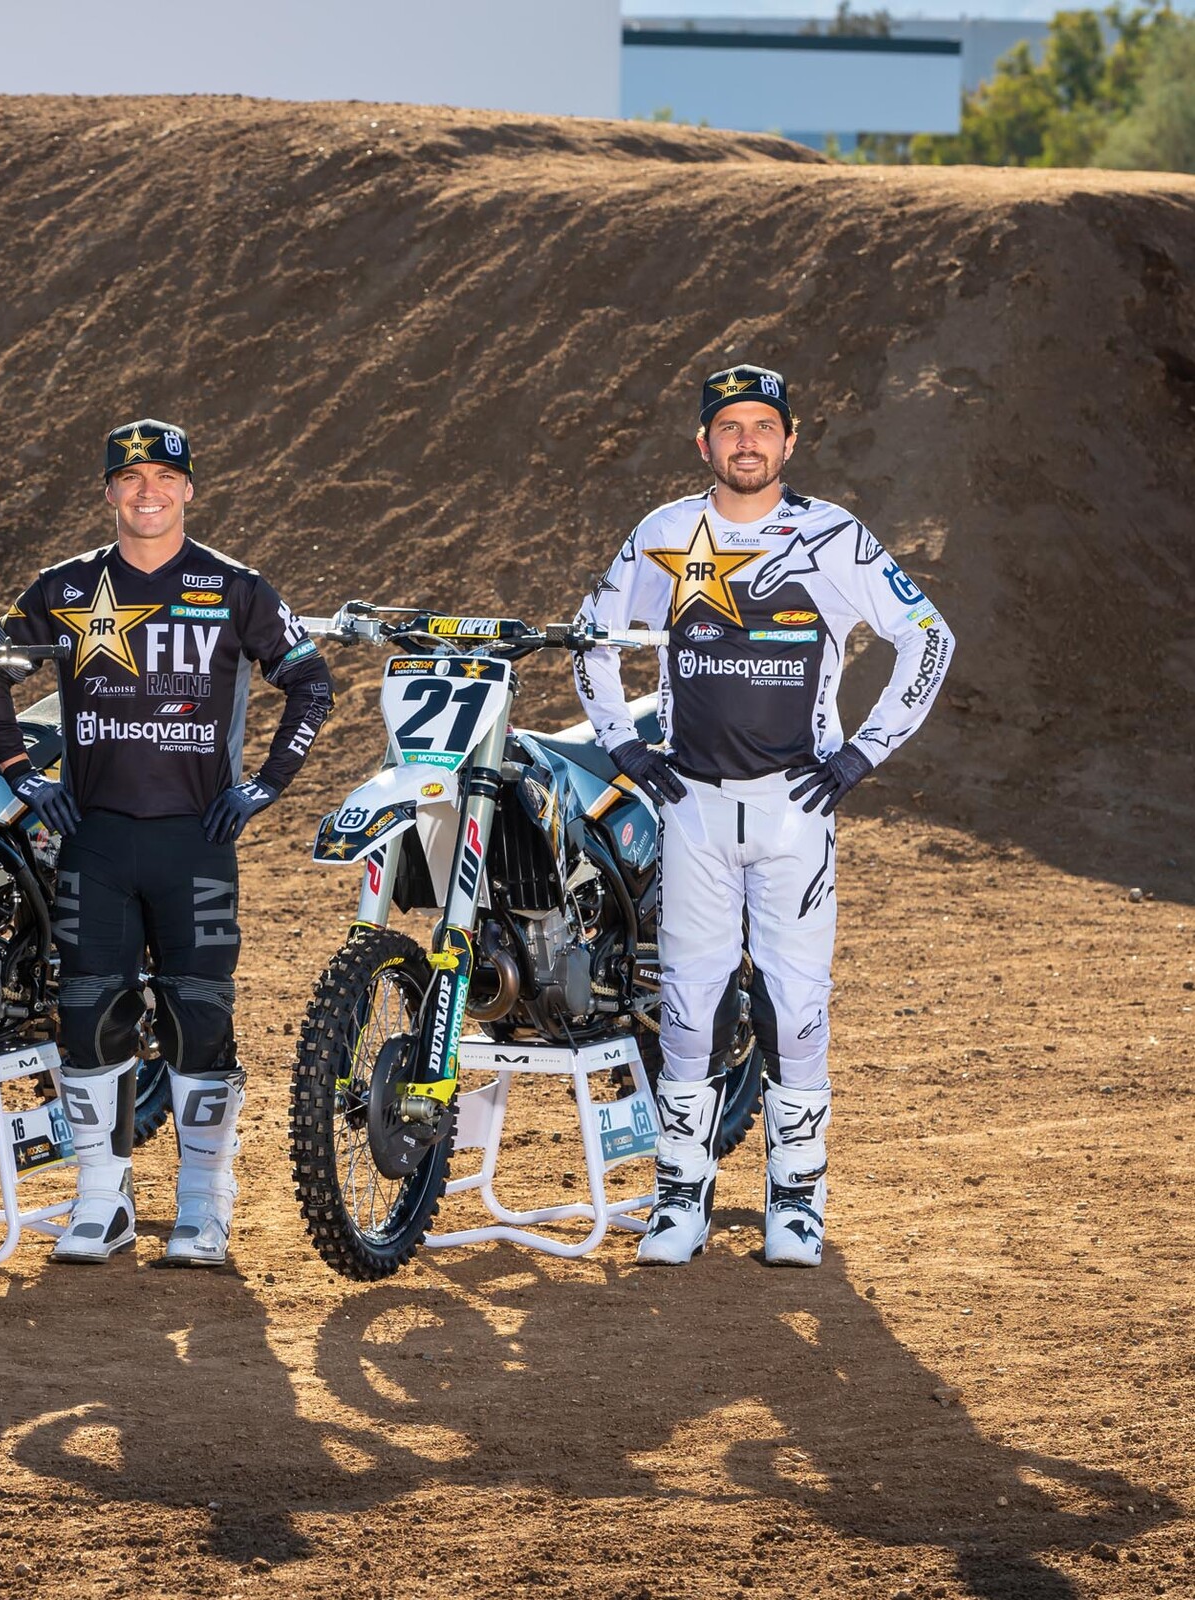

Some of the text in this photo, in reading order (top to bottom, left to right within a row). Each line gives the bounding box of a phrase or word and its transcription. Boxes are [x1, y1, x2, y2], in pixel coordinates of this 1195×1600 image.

[183, 574, 223, 588] WPS
[186, 607, 229, 618] MOTOREX
[766, 632, 814, 640] MOTOREX
[145, 623, 222, 674] FLY
[392, 660, 435, 670] ROCKSTAR
[697, 655, 805, 679] Husqvarna
[900, 627, 940, 710] ROCKSTAR
[919, 637, 949, 706] ENERGY DRINK
[146, 673, 211, 697] RACING
[394, 678, 492, 753] 21
[99, 718, 215, 743] Husqvarna
[288, 722, 317, 757] FLY
[192, 746, 215, 754] RACING
[417, 754, 456, 764] MOTOREX
[421, 783, 444, 797] FMF
[365, 811, 395, 837] ROCKSTAR
[193, 876, 239, 948] FLY
[429, 974, 452, 1074] DUNLOP
[449, 981, 468, 1055] MOTOREX
[11, 1117, 25, 1141] 16
[598, 1108, 612, 1131] 21
